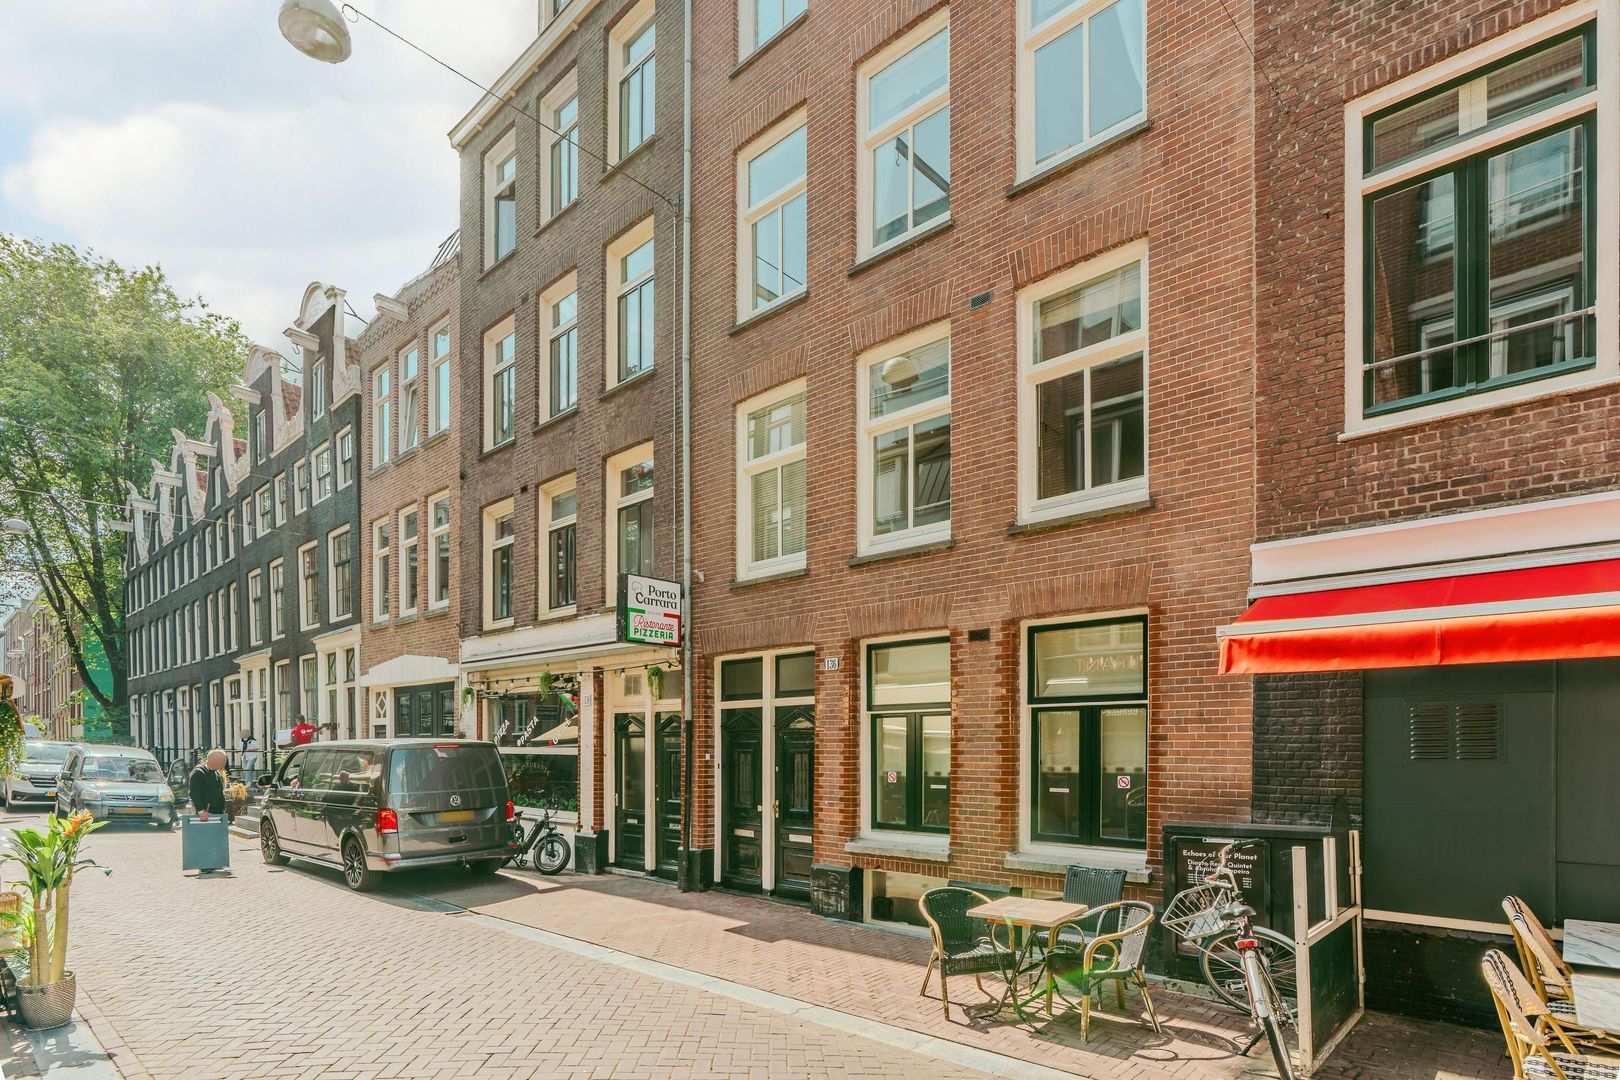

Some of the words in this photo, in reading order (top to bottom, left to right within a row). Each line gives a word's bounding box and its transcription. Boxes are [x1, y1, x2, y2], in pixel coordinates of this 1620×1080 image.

[648, 585, 677, 600] Porto
[635, 592, 677, 610] Carrara
[633, 614, 675, 632] Ristorante
[633, 627, 674, 640] PIZZERIA
[827, 657, 837, 670] 136
[493, 719, 510, 744] PIZZA
[521, 716, 540, 745] PASTA
[1182, 849, 1206, 857] Echoes
[1233, 852, 1258, 861] Planet
[1227, 861, 1253, 870] Quintet
